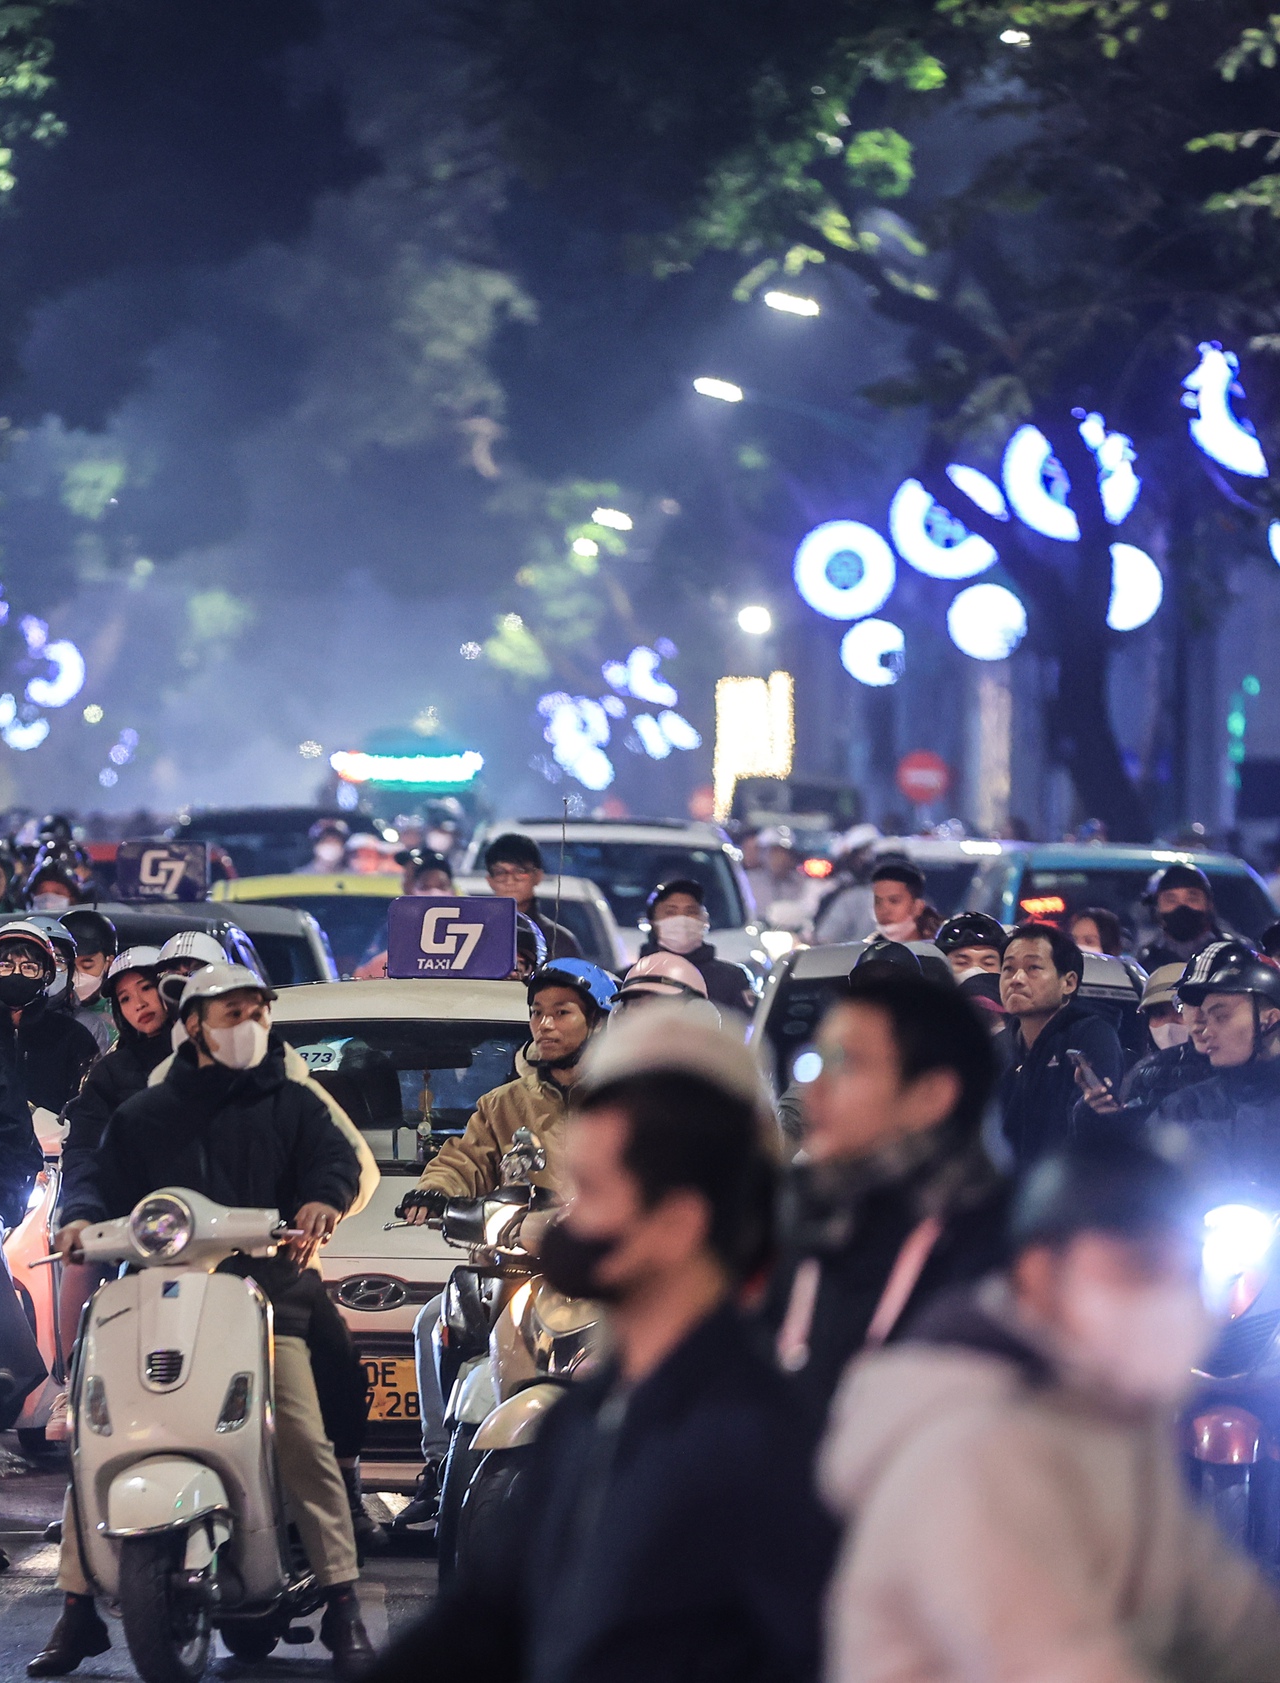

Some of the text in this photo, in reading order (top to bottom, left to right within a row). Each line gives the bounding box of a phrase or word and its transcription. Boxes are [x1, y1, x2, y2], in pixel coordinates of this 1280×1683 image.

[140, 849, 186, 895] G7
[420, 906, 485, 970] G7
[416, 958, 451, 970] TAXI
